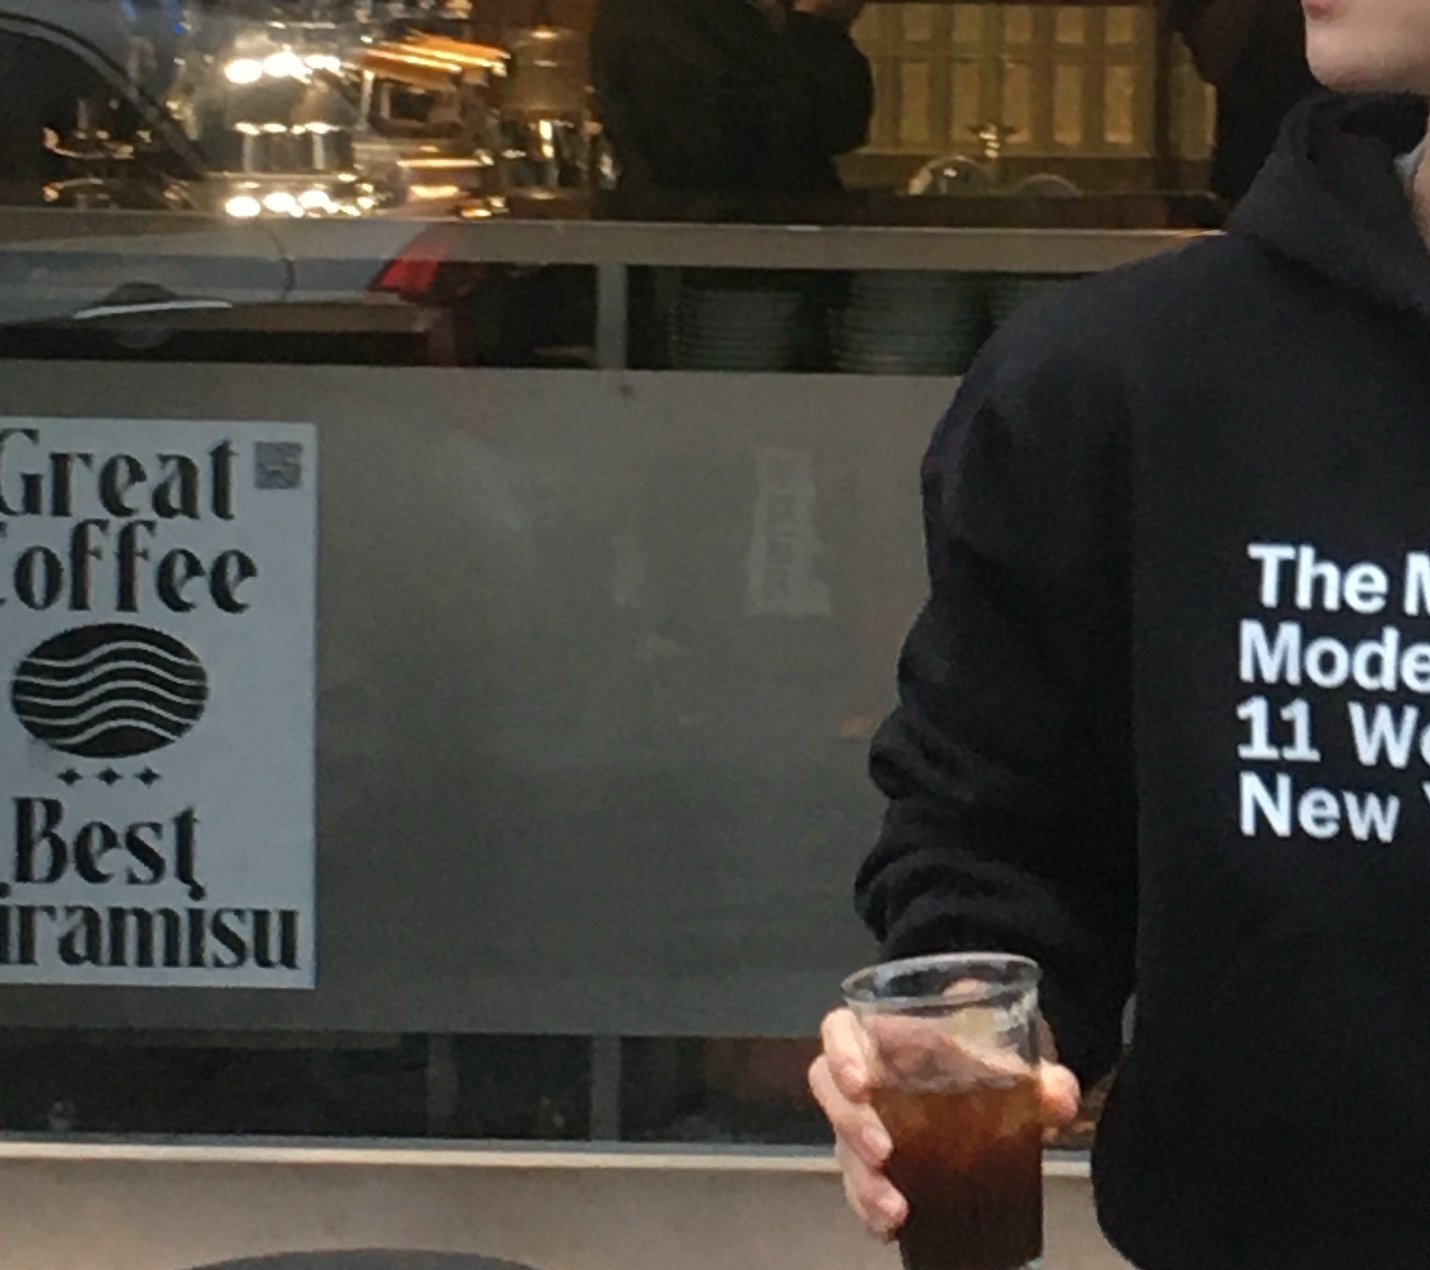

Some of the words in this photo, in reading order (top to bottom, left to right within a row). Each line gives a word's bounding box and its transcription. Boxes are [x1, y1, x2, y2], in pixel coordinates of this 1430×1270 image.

[0, 518, 259, 614] offee
[1247, 542, 1389, 615] The
[1236, 695, 1322, 763] 11
[11, 797, 203, 887] Best
[1239, 770, 1400, 844] New
[0, 882, 301, 970] iramisu
